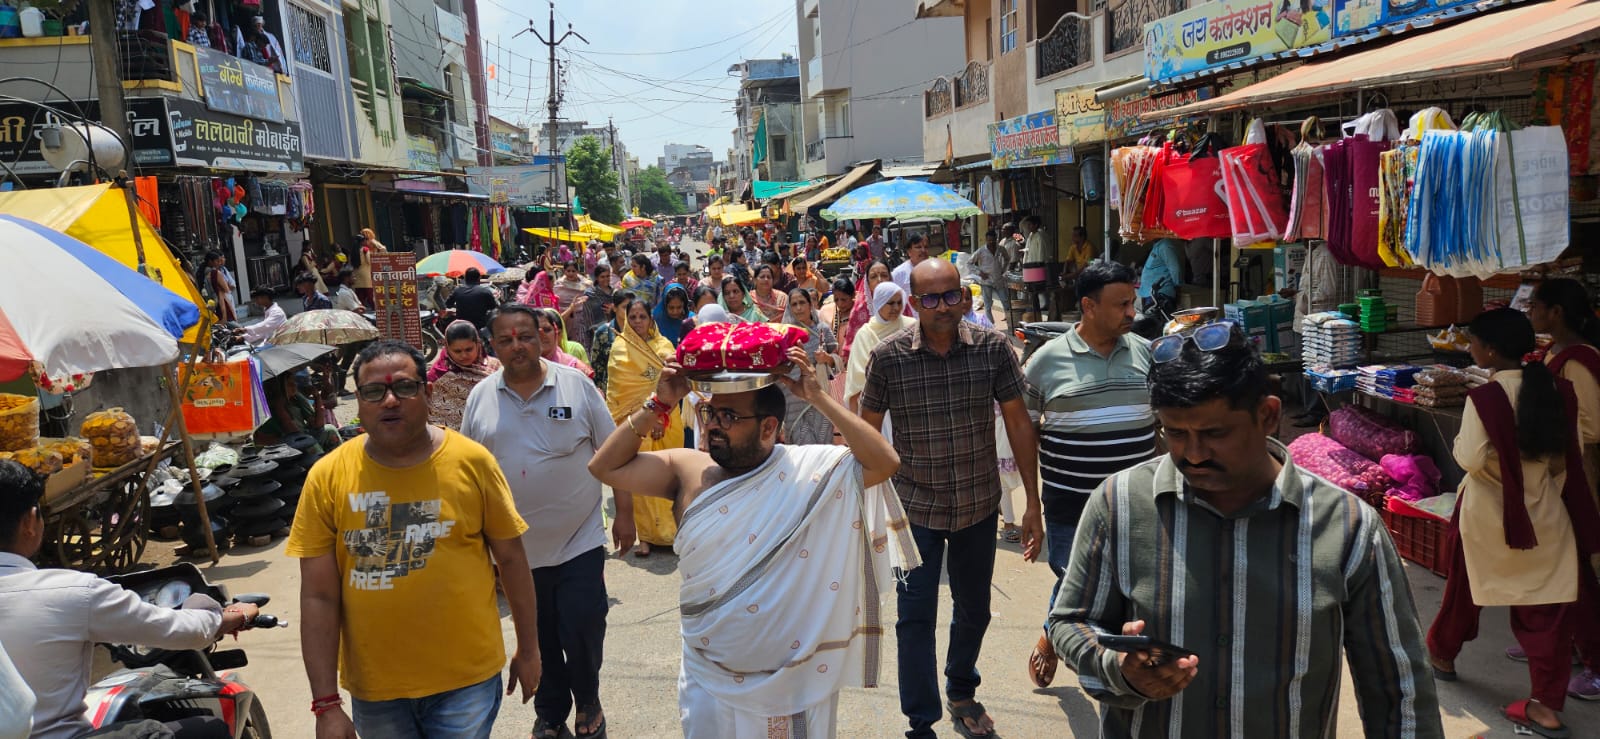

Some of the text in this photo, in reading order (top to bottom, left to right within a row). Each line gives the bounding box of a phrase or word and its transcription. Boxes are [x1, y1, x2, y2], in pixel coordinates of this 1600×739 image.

[1182, 1, 1273, 48] जय कलेक्शन
[195, 119, 254, 146] ललवानी
[255, 122, 300, 155] मोबाईल
[348, 491, 390, 513] WE
[405, 520, 456, 544] RIDE
[350, 569, 396, 590] FREE
